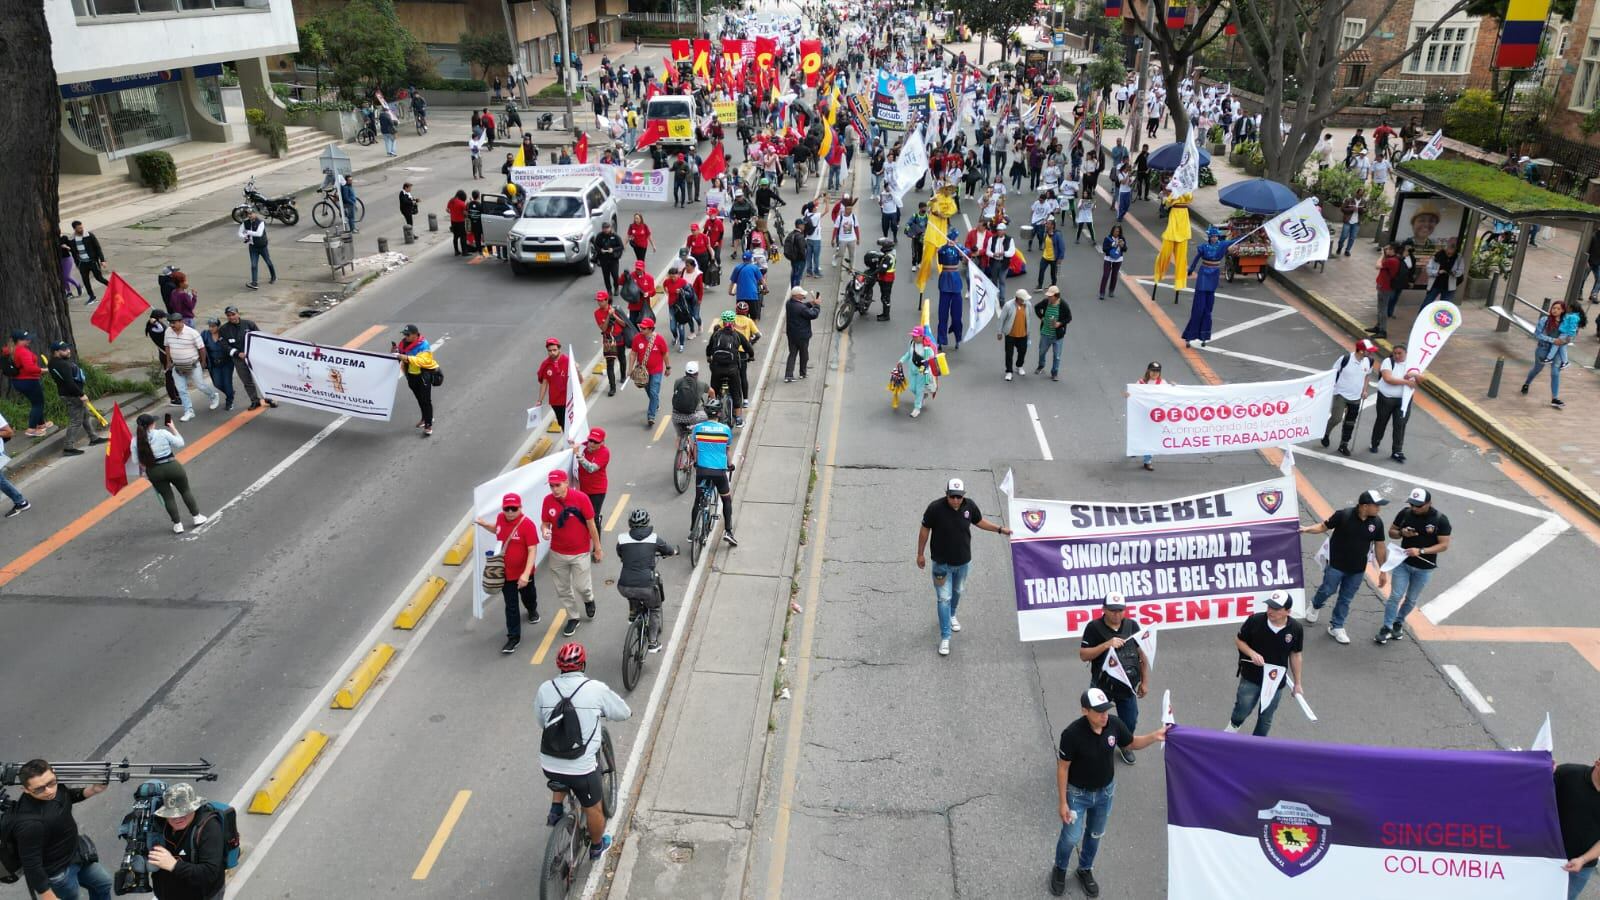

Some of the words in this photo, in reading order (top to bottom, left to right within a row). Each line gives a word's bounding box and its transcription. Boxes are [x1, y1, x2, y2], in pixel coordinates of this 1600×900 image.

[1037, 95, 1048, 124] CUT
[348, 396, 375, 405] LUCHA
[1152, 401, 1288, 422] FENALGRAP
[1162, 422, 1242, 435] Acompañando
[1244, 420, 1258, 431] las
[1260, 417, 1290, 429] luchas
[1162, 436, 1210, 449] CLASE
[1214, 427, 1310, 446] TRABAJADORA
[1071, 493, 1233, 528] SINGEBEL
[1060, 539, 1151, 570] SINDICATO
[1155, 532, 1227, 563] GENERAL
[1231, 531, 1251, 557] DE
[1024, 570, 1153, 605] TRABAJADORES
[1156, 567, 1177, 594] DE
[1179, 561, 1258, 593] BEL-STAR
[1261, 559, 1294, 586] S.A.
[1380, 821, 1511, 849] SINGEBEL
[1384, 855, 1505, 880] COLOMBIA
